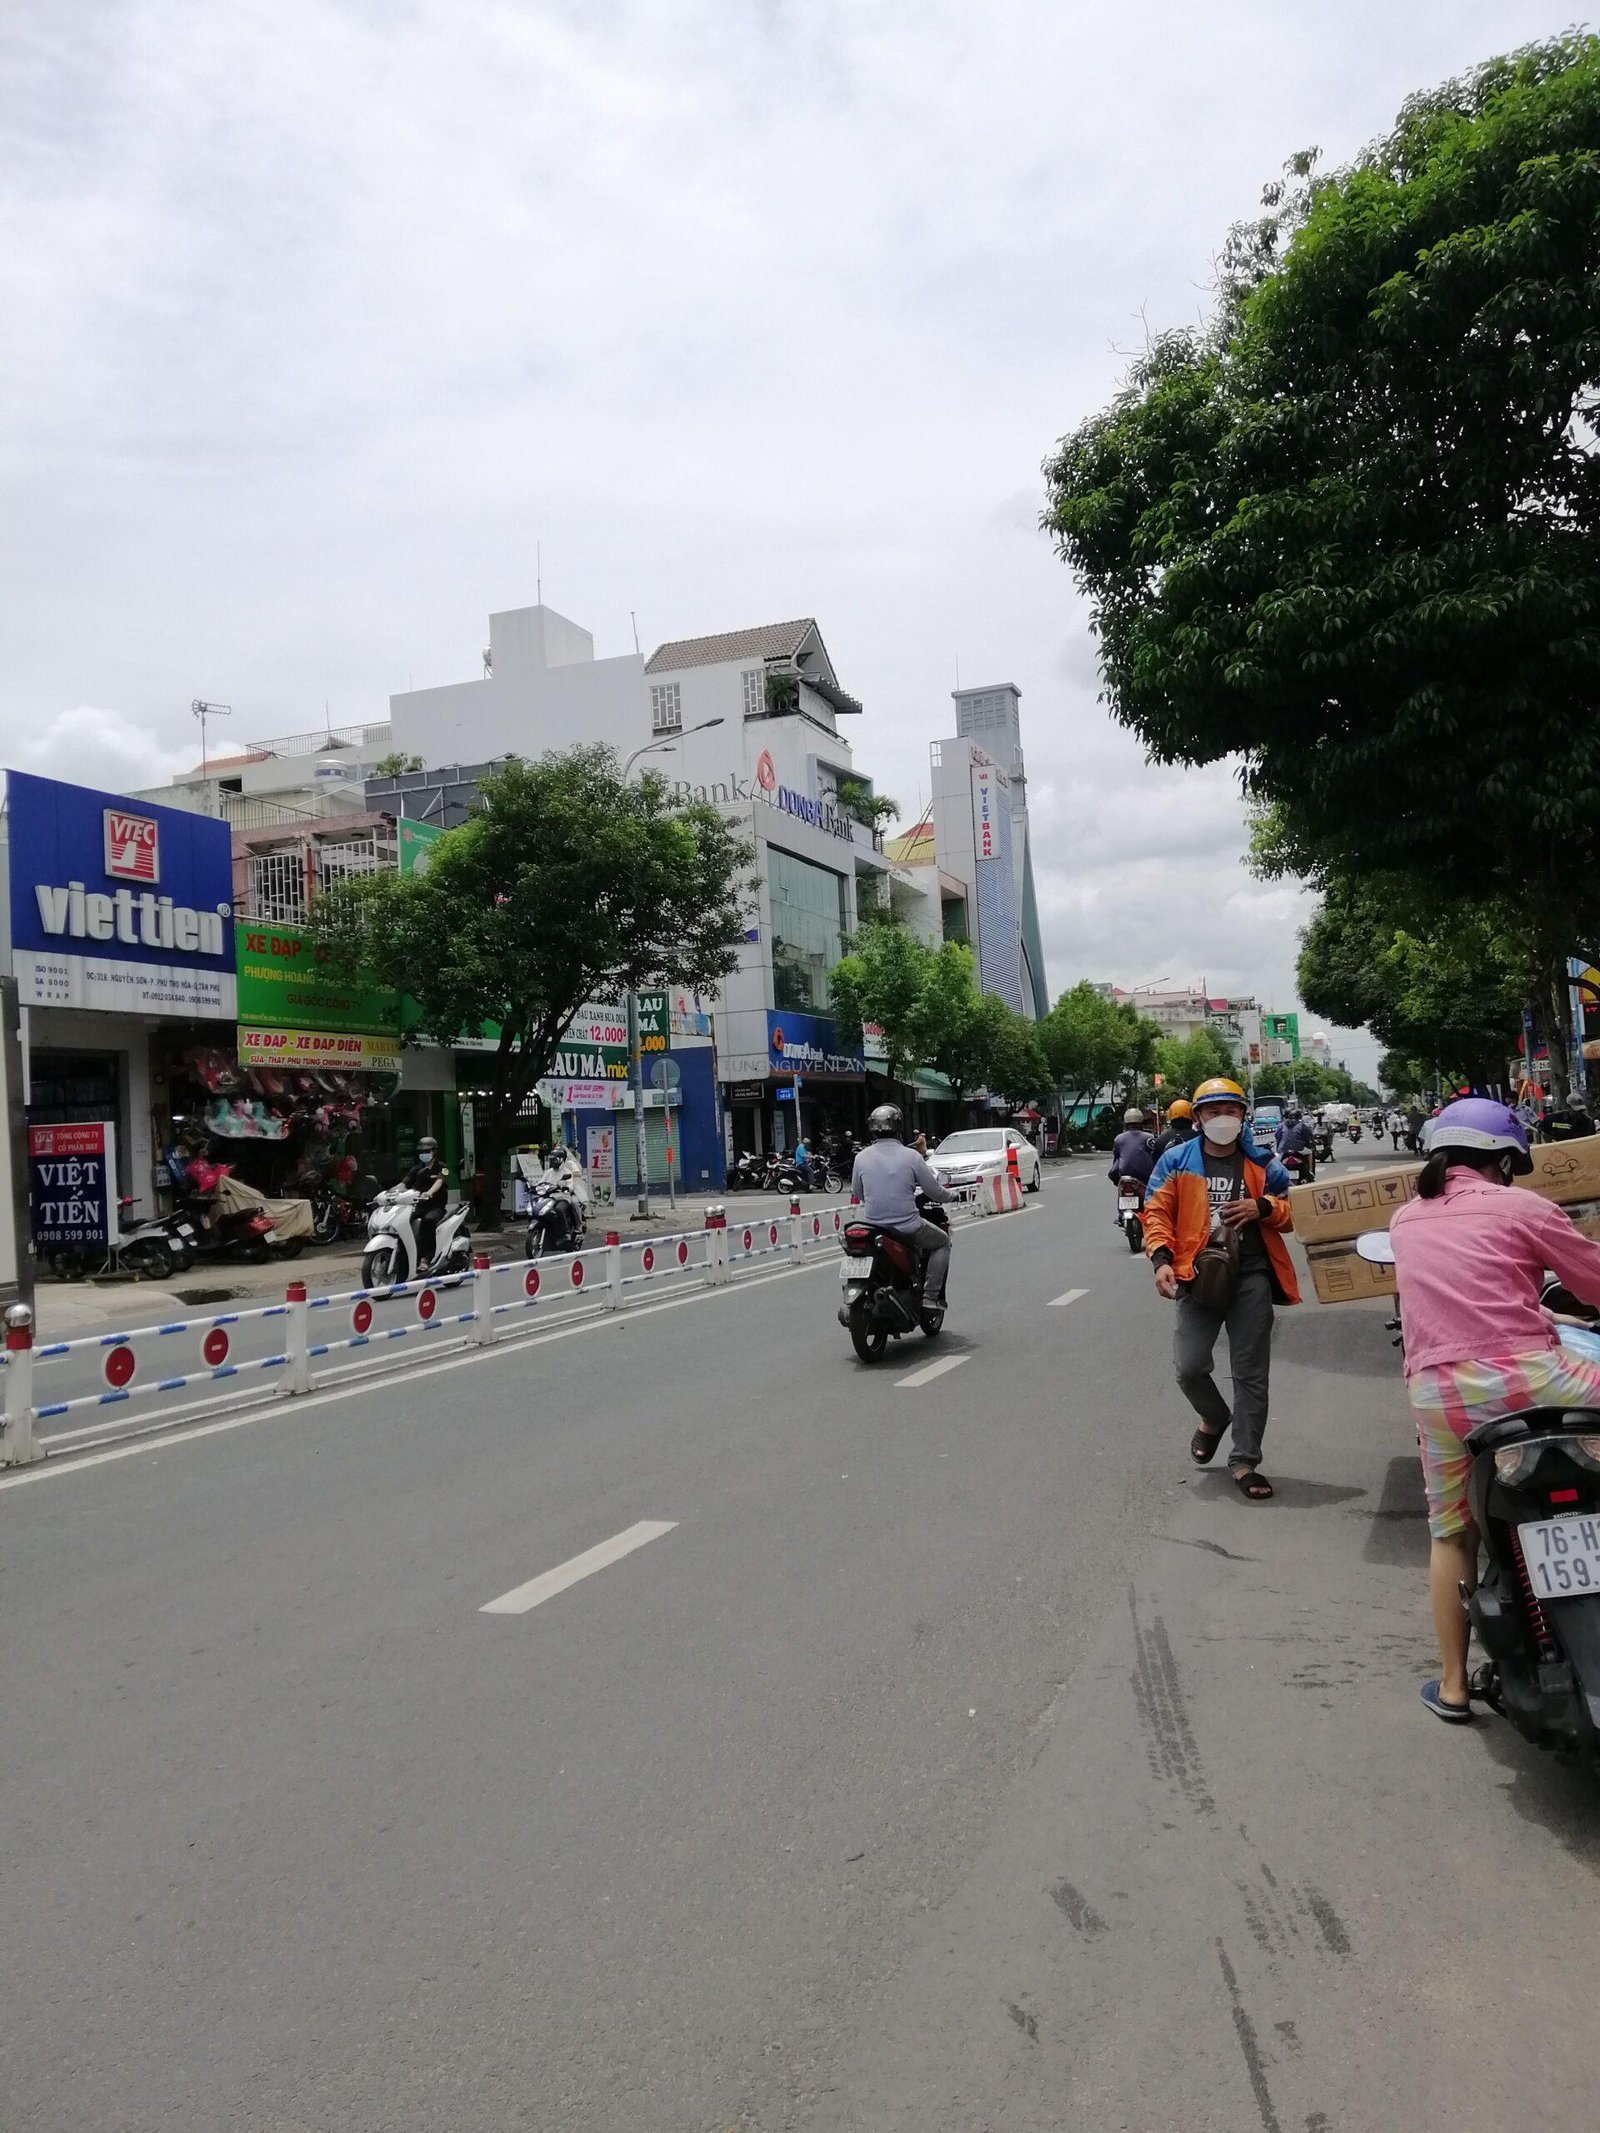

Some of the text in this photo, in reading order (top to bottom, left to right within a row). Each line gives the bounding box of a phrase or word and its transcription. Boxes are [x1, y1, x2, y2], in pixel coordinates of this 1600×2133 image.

[673, 771, 752, 803] Bank
[111, 815, 154, 845] VTEC
[825, 803, 854, 842] Bank
[980, 787, 992, 856] VIETBANK
[246, 933, 266, 955] XE
[270, 937, 301, 961] ĐẠP
[245, 1032, 261, 1046] XE
[296, 1036, 311, 1049] XE
[372, 1056, 396, 1068] PEGA
[544, 1047, 629, 1079] AU MÁ mix
[37, 1156, 99, 1191] VIỆT
[592, 1156, 600, 1169] 1
[40, 1190, 100, 1224] TIẾN
[37, 1229, 104, 1241] 0908 599 901
[1536, 1521, 1600, 1557] 76-H
[1537, 1555, 1600, 1592] 159.
